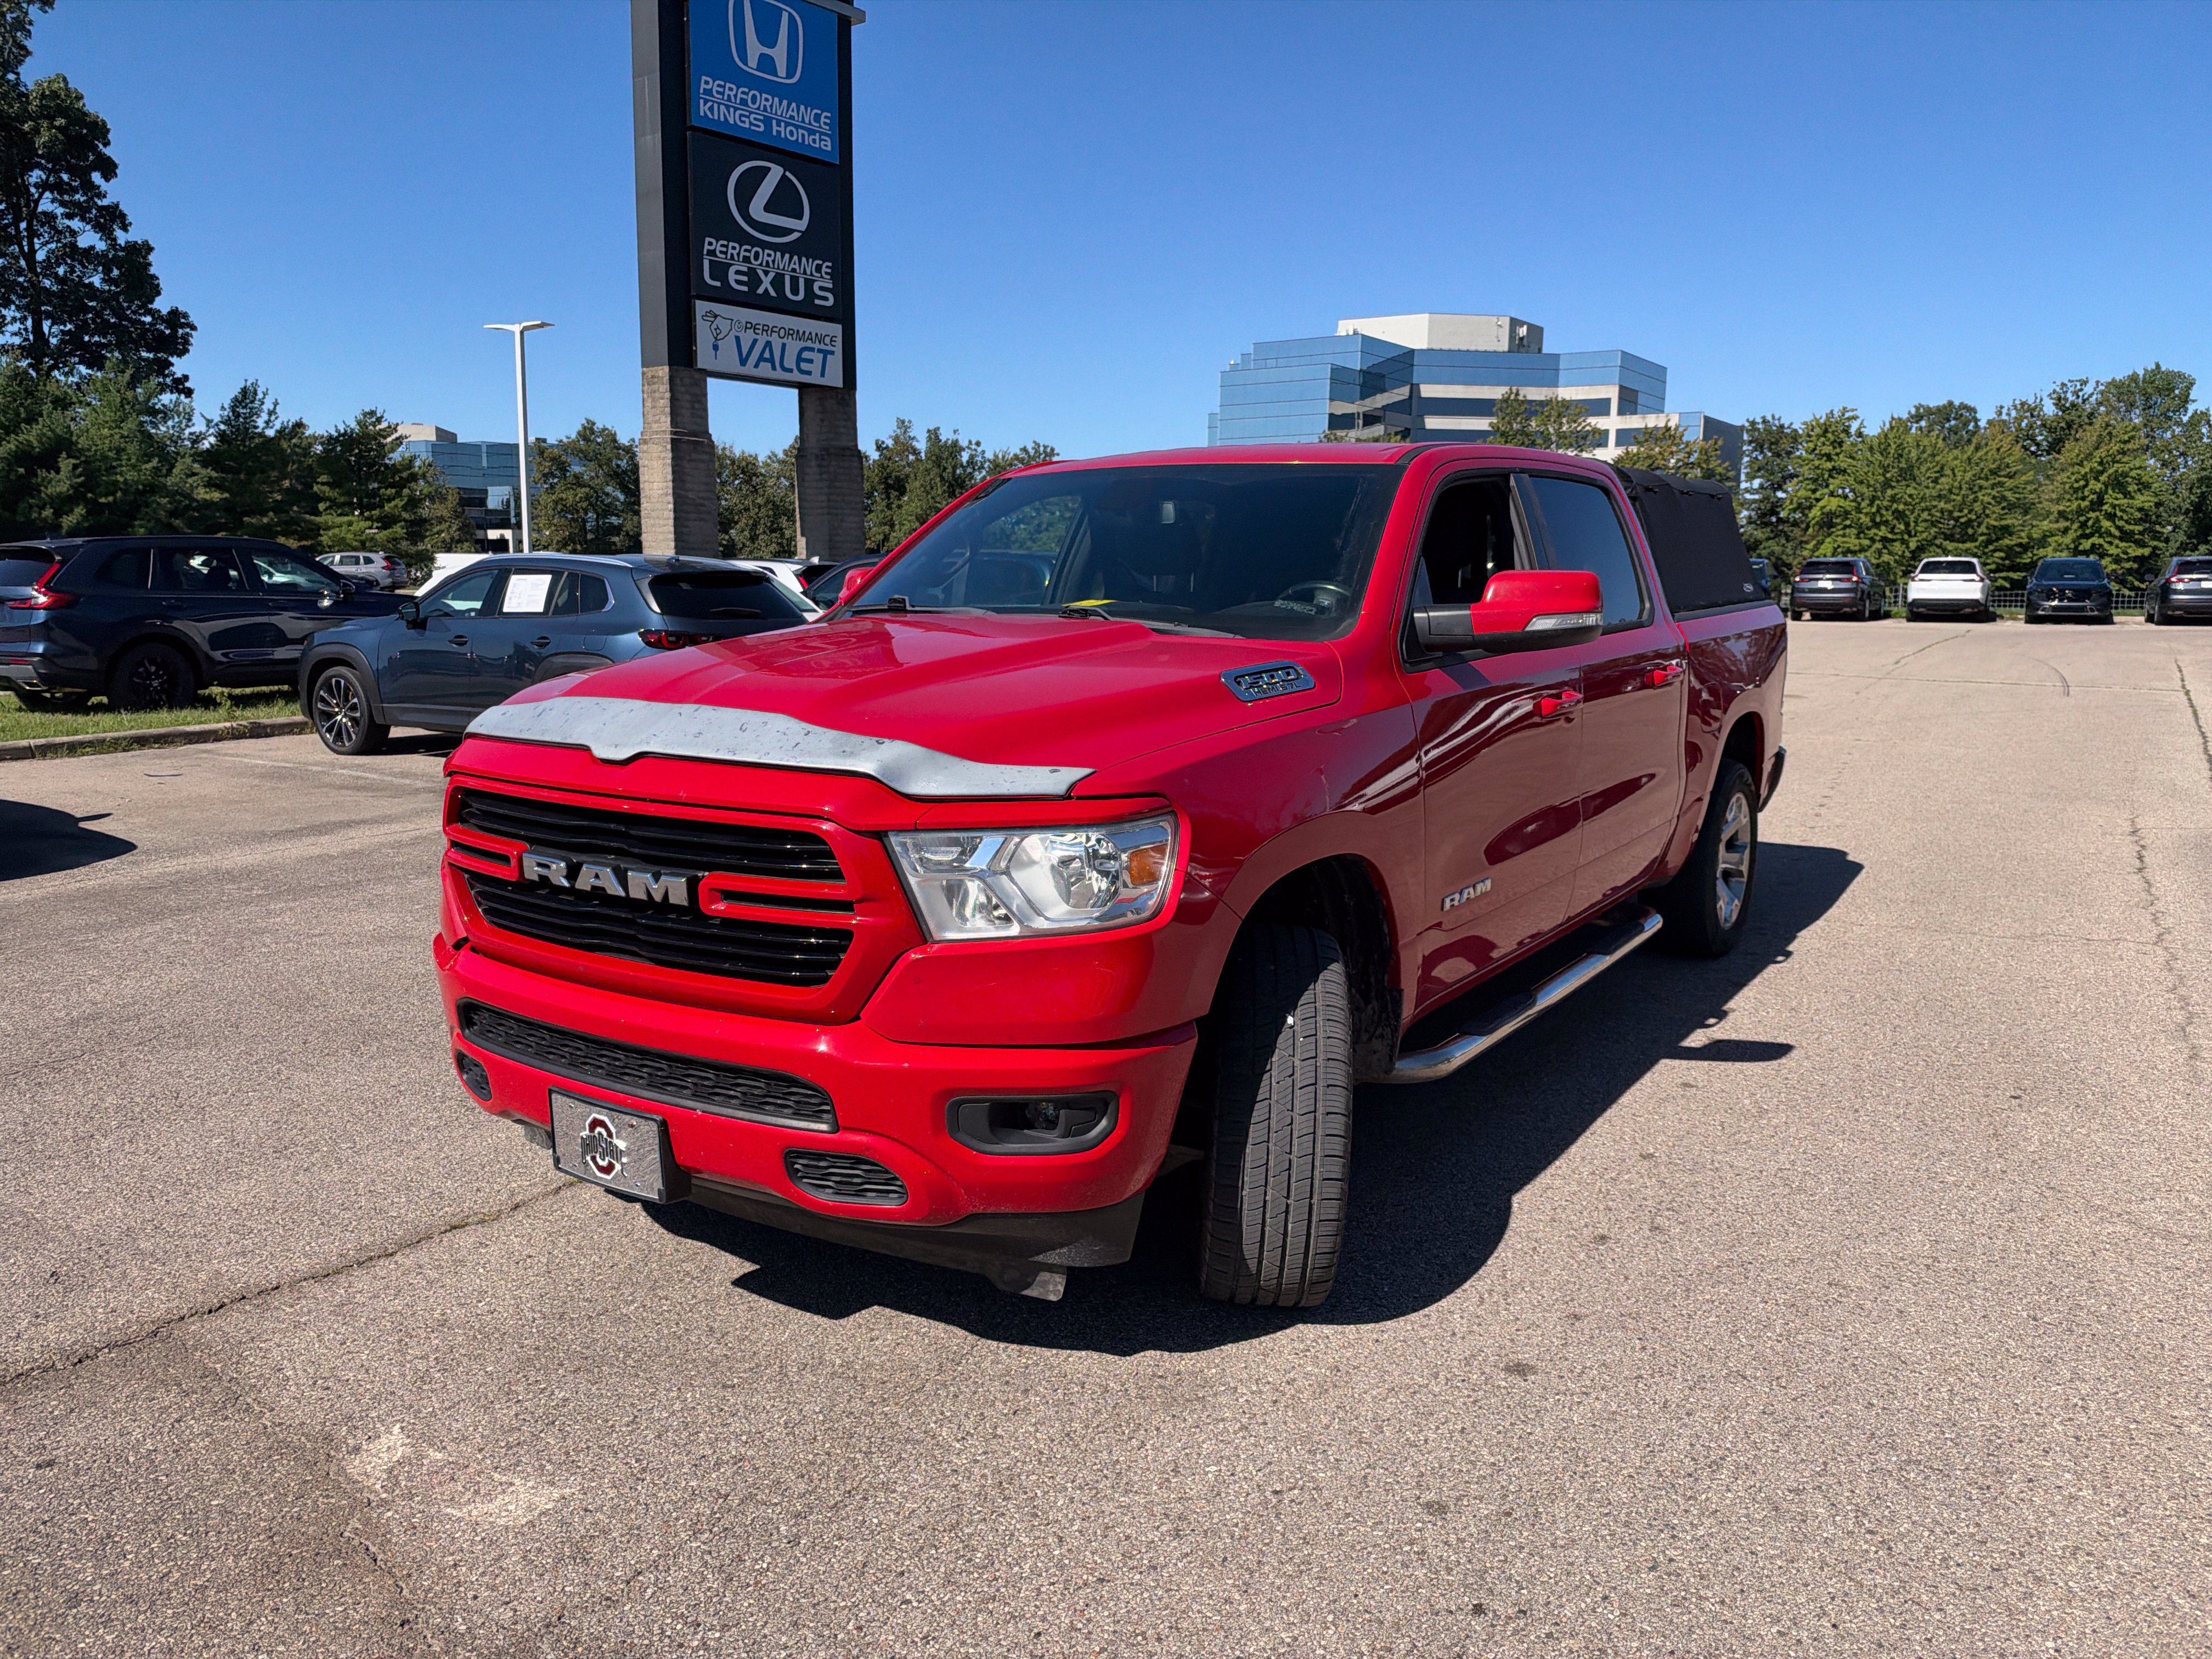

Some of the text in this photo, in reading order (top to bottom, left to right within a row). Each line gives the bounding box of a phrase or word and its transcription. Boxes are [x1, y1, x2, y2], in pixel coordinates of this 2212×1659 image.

[699, 76, 831, 130] PERFORMANCE
[699, 99, 832, 151] KINGS Honda
[703, 237, 832, 279] PERFORMANCE
[703, 259, 834, 306] LEXUS
[744, 321, 837, 347] PERFORMANCE
[734, 335, 835, 378] VALET
[1237, 668, 1297, 689] 1500
[1250, 684, 1280, 697] HEMI
[523, 852, 689, 906] RAM
[1441, 877, 1491, 911] RAM
